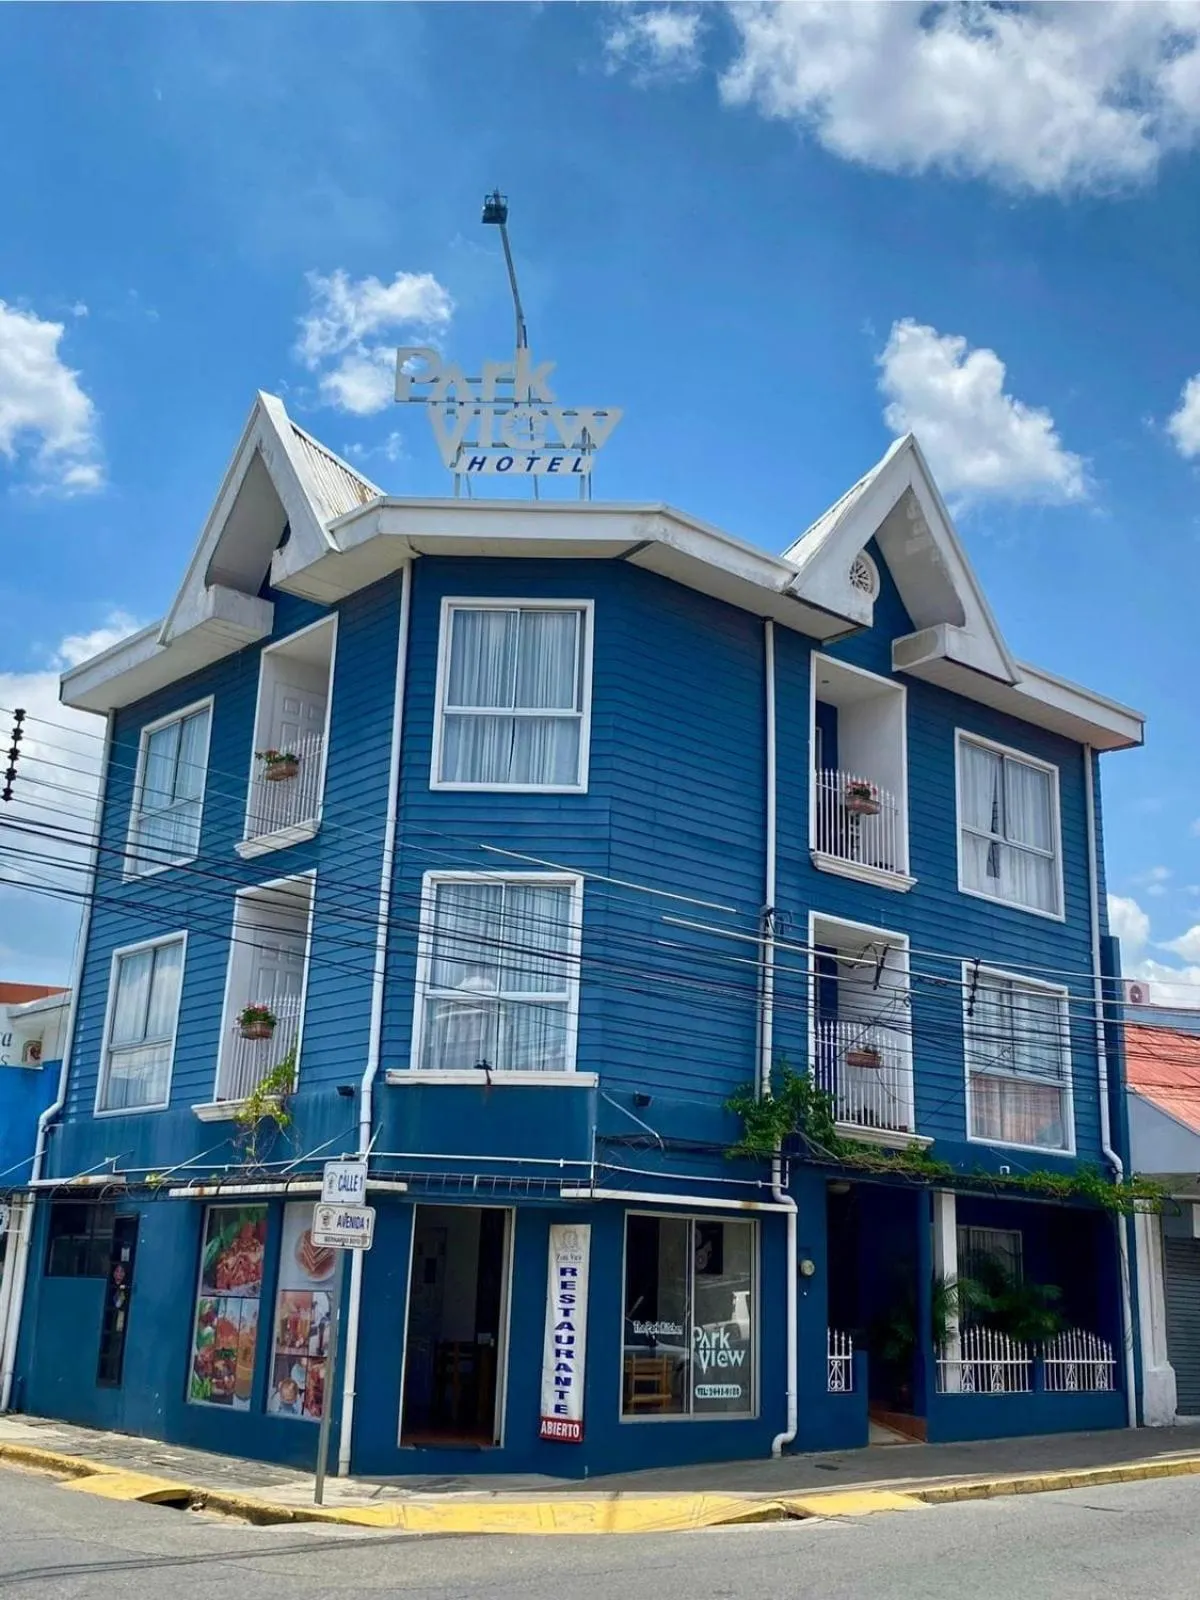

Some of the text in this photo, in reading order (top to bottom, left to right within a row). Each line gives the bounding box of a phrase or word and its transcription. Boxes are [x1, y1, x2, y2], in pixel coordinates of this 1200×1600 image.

[467, 455, 585, 473] HOTEL
[338, 1174, 358, 1192] CALLE
[336, 1215, 365, 1230] AVENIDA
[554, 1266, 578, 1415] RESTAURANTE
[541, 1420, 580, 1438] ABIERTO
